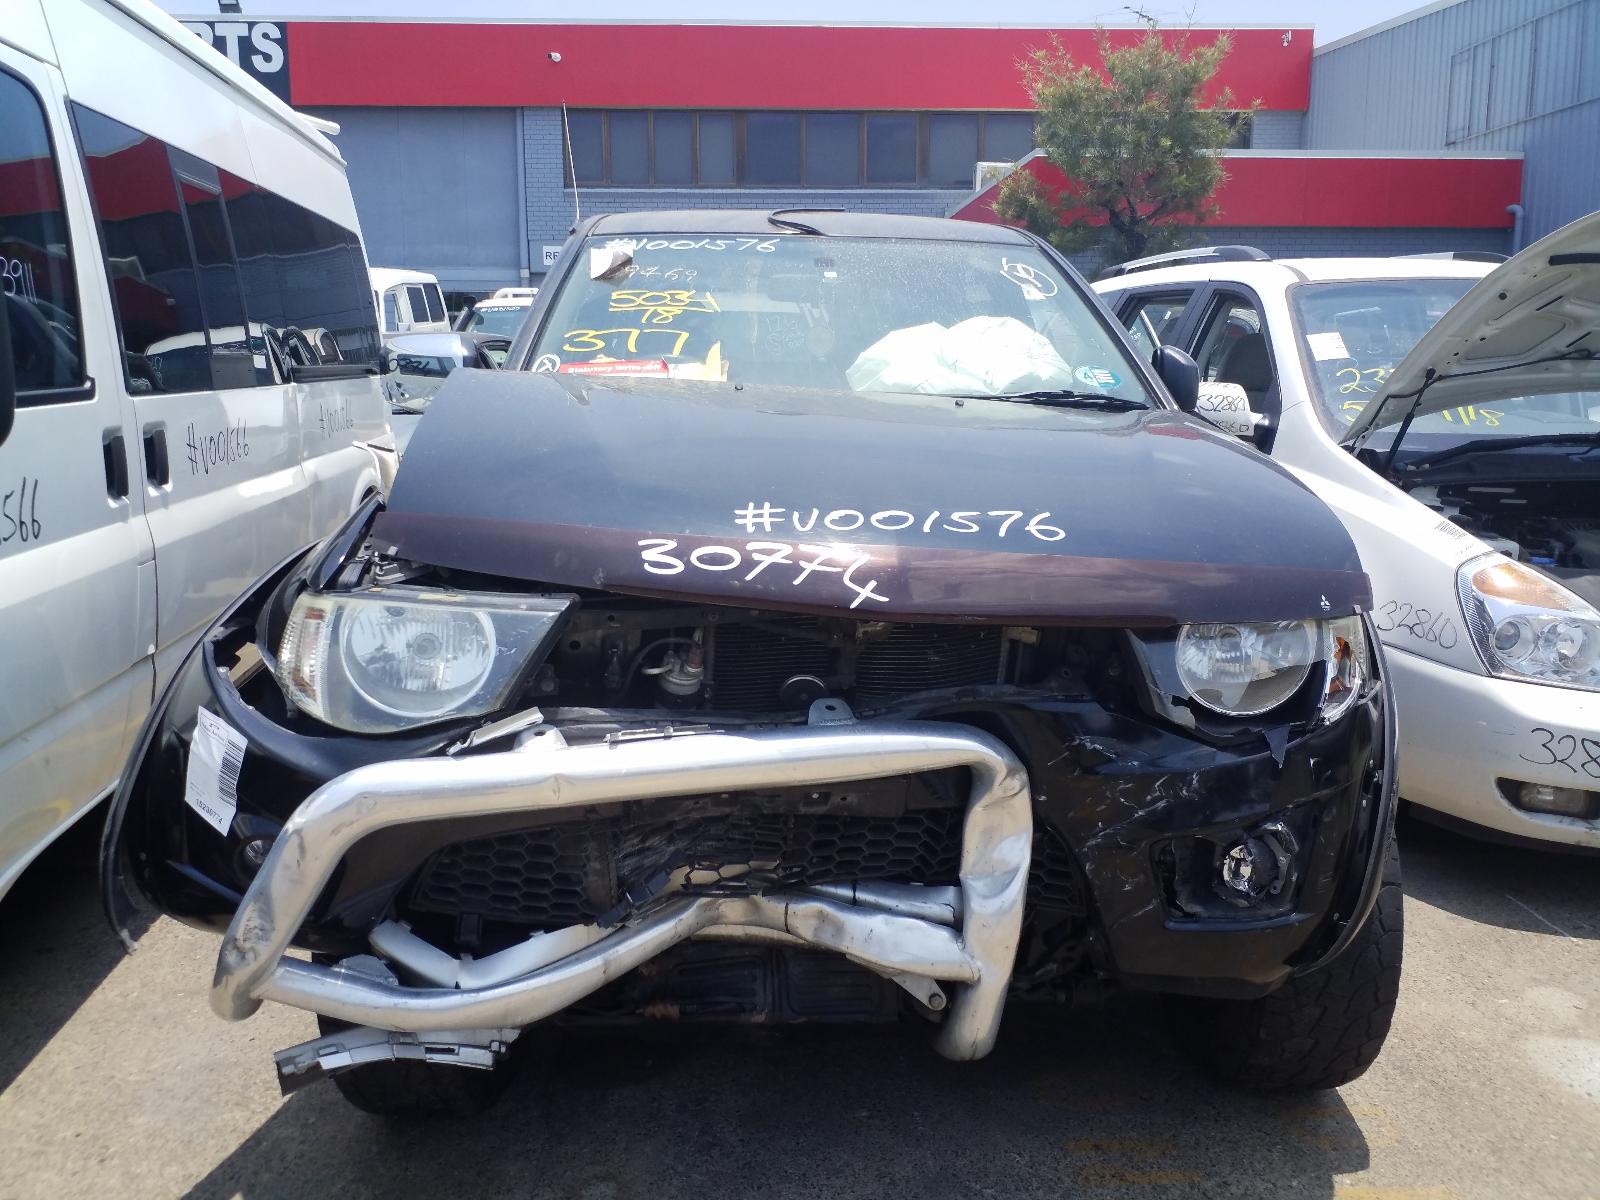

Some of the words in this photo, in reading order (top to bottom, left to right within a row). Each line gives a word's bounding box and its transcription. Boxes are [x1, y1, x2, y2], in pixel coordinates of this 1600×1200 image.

[562, 328, 689, 358] 377
[1336, 367, 1395, 393] 23
[186, 417, 250, 476] #V001566
[734, 502, 1066, 541] #V001576
[638, 538, 889, 609] 30774
[1377, 600, 1458, 649] 32860
